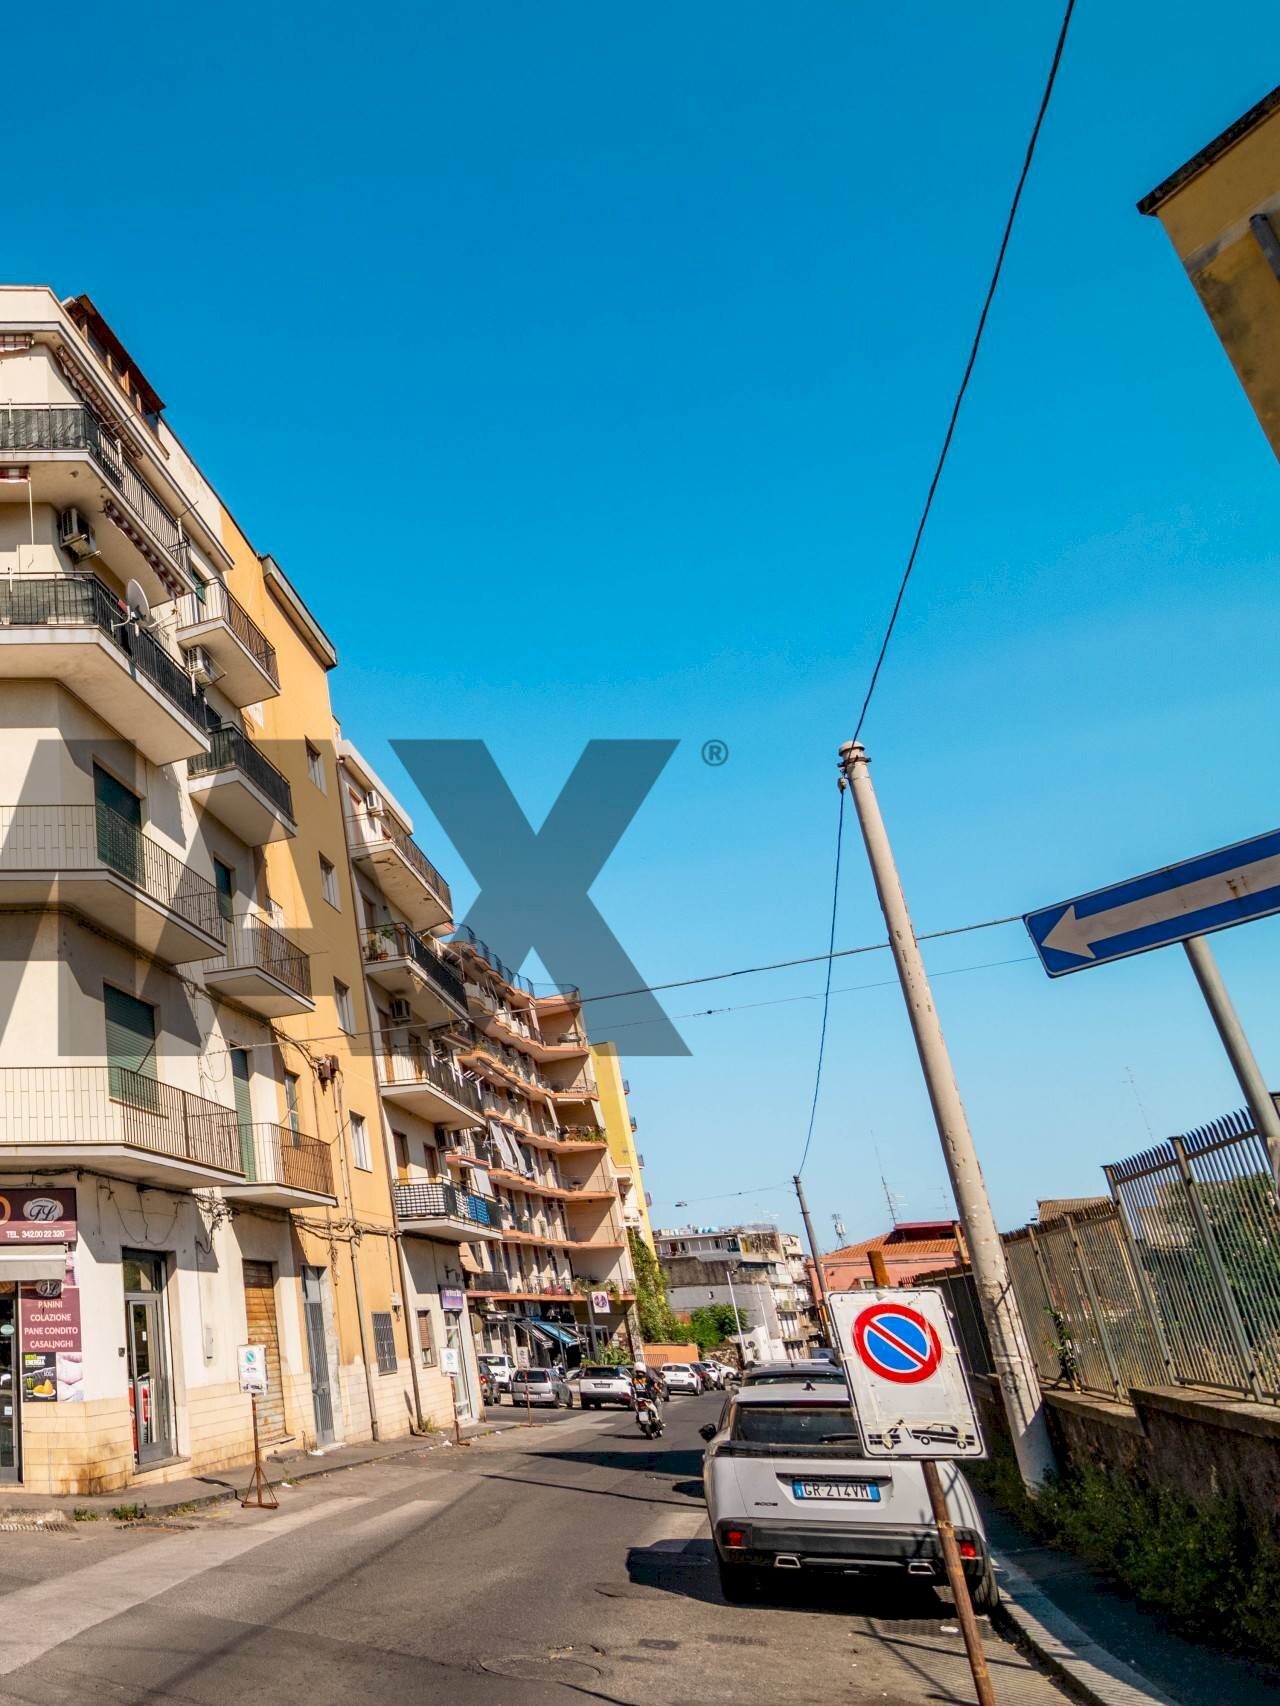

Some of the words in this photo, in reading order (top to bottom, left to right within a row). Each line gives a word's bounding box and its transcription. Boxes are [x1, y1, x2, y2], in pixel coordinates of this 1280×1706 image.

[38, 1300, 63, 1309] PANINI
[30, 1313, 72, 1321] COLAZIONE
[24, 1327, 44, 1335] PANE
[44, 1326, 79, 1335] CONDITO
[30, 1340, 74, 1349] CASALINGHI
